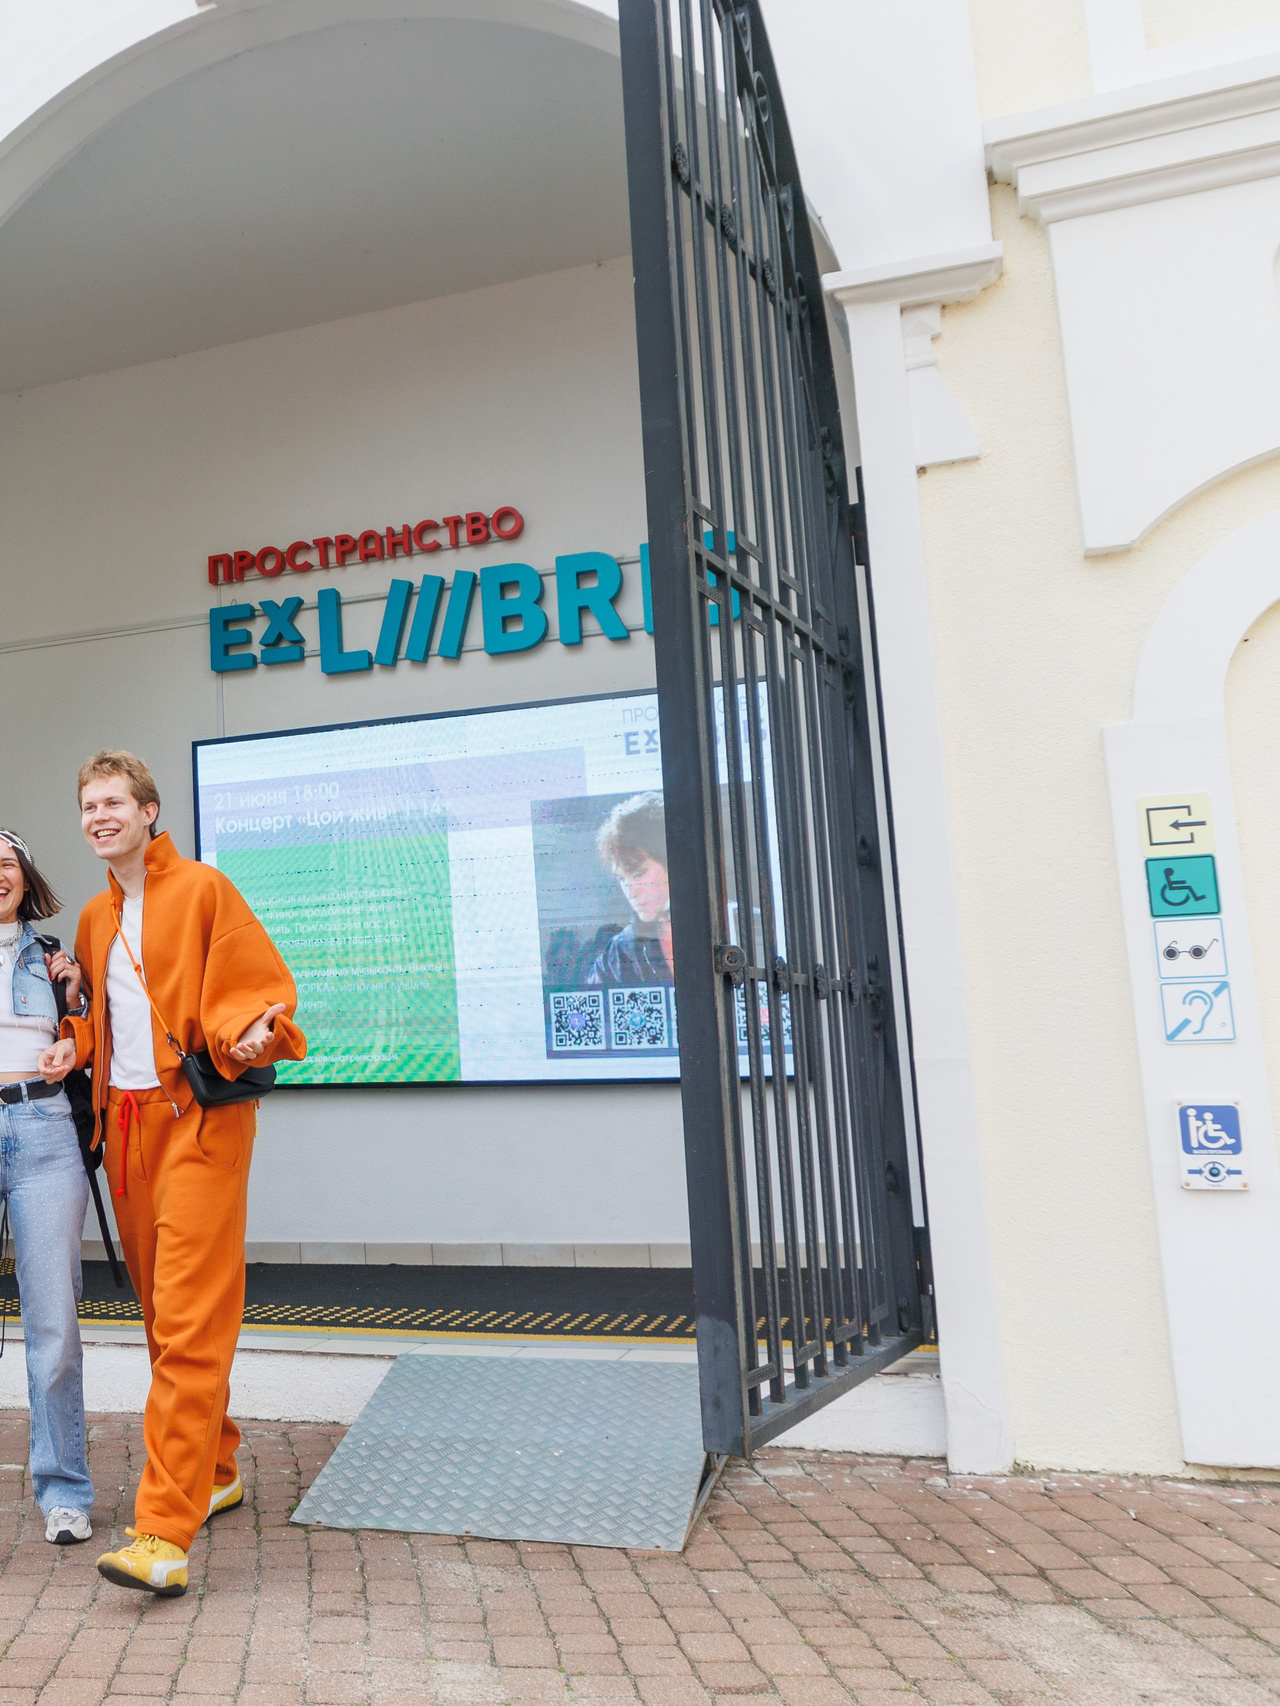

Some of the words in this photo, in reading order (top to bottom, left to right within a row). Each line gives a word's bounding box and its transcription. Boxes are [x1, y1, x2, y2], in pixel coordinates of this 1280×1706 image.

[208, 506, 525, 585] ПРОСТРАНСТВО
[209, 596, 306, 673] EX
[214, 793, 233, 811] 21
[239, 790, 287, 808] июня
[294, 781, 340, 803] 18:00
[215, 815, 293, 835] Концерт
[298, 808, 344, 828] «Цой
[295, 920, 361, 934] Приглашаем
[290, 966, 349, 978] алантливые
